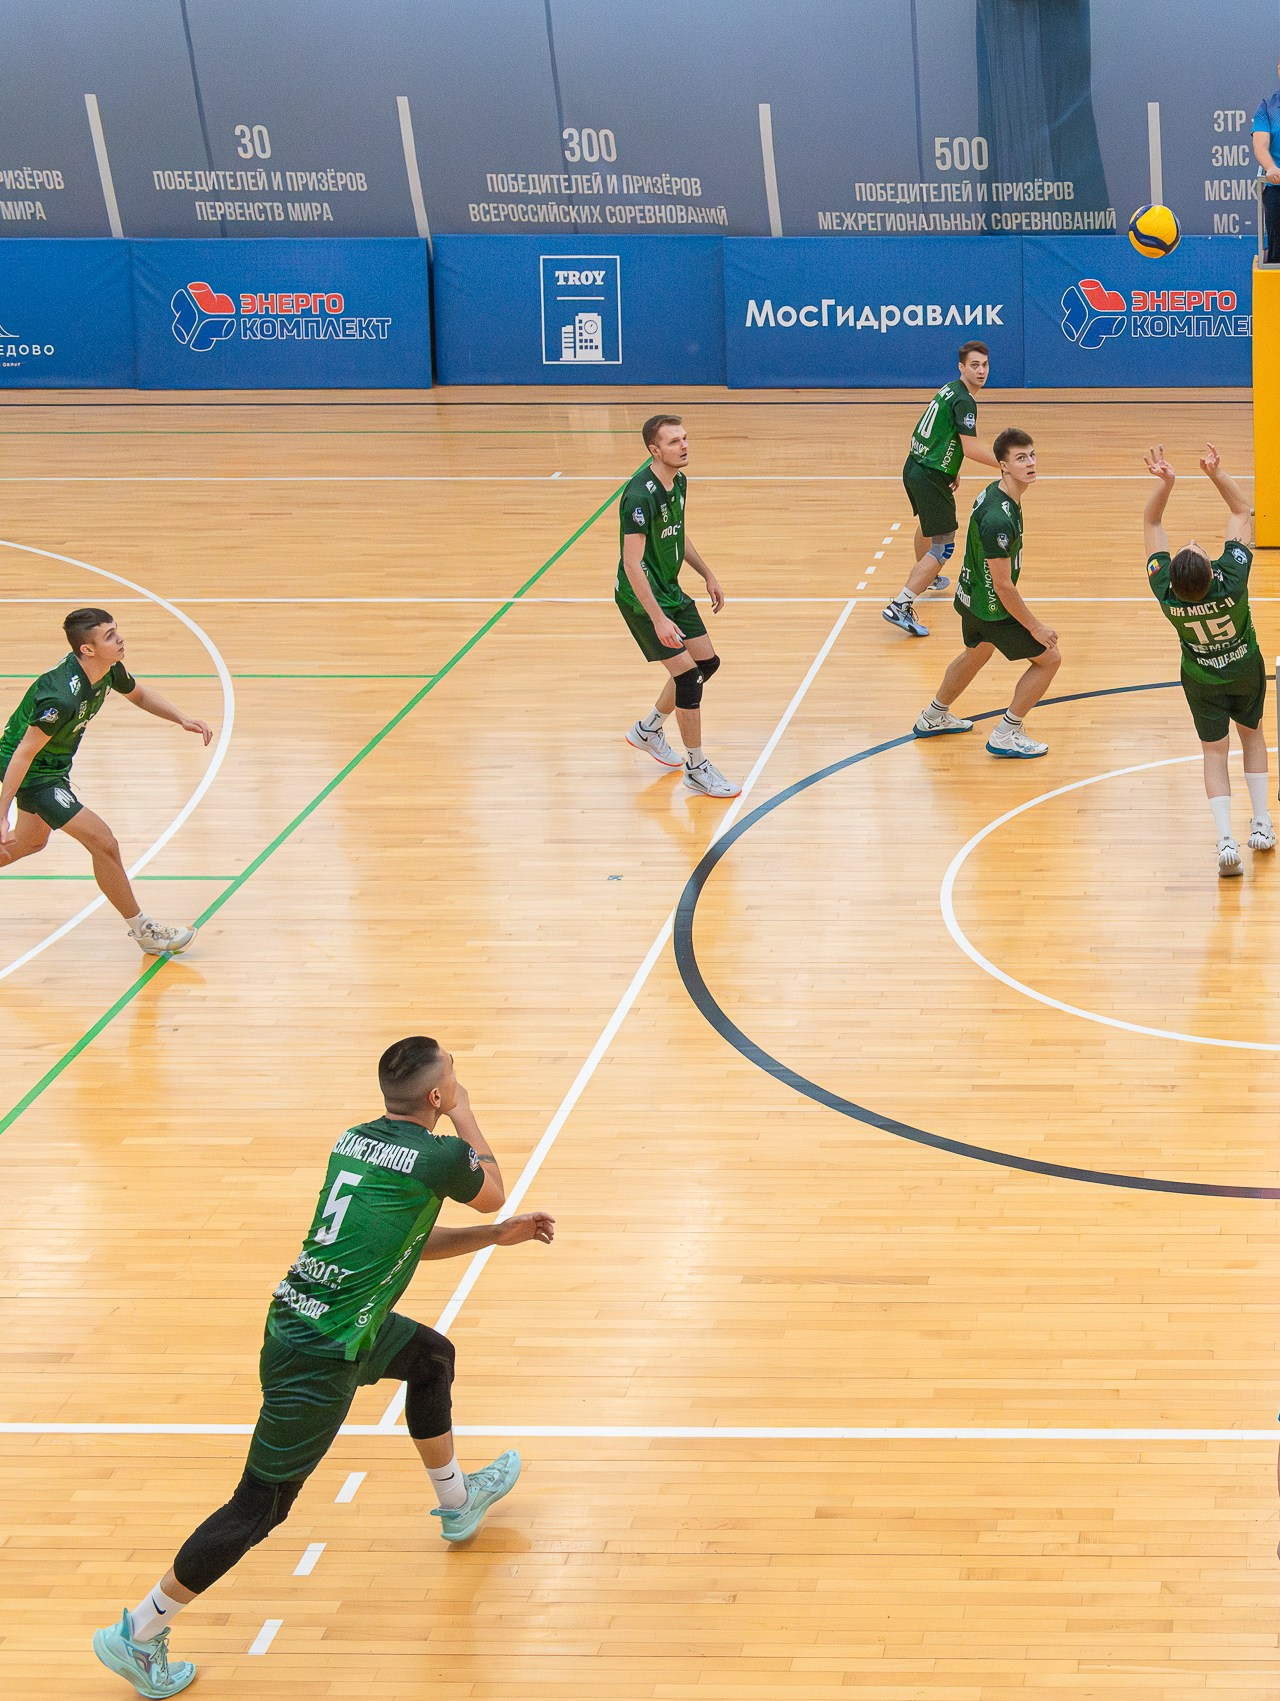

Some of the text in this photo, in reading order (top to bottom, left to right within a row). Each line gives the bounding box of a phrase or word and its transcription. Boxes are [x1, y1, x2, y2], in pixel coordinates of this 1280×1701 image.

[1213, 110, 1247, 133] ЗТР
[234, 124, 272, 159] 30
[562, 127, 618, 163] 300
[934, 136, 989, 171] 500
[1211, 145, 1250, 167] ЗМС
[153, 168, 368, 192] ПОБЕДИТЕЛЕЙ И ПРИЗЁРОВ
[486, 172, 702, 197] ПОБЕДИТЕЛЕЙ И ПРИЗЁРОВ
[854, 179, 1075, 204] ПОБЕДИТЕЛЕЙ И ПРИЗЁРОВ
[1204, 179, 1260, 202] МСМК
[0, 200, 47, 221] МИРА
[195, 201, 334, 222] ПЕРВЕНСТВ МИРА
[468, 201, 729, 227] ВСЕРОССИЙСКИХ СОРЕВНОВАНИЙ
[817, 207, 1117, 232] МЕЖРЕГИОНАЛЬНЫХ СОРЕВНОВАНИЙ
[555, 270, 606, 286] TROY
[240, 292, 345, 315] ЭНЕРГО
[1131, 289, 1237, 312] ЭНЕРГО
[745, 298, 1004, 333] МосГидравлик
[1131, 314, 1253, 338] КОМПЛЕ
[240, 317, 392, 341] КОМПЛЕКТ
[917, 400, 939, 439] 10
[1183, 614, 1237, 645] 15
[314, 1169, 364, 1246] 5
